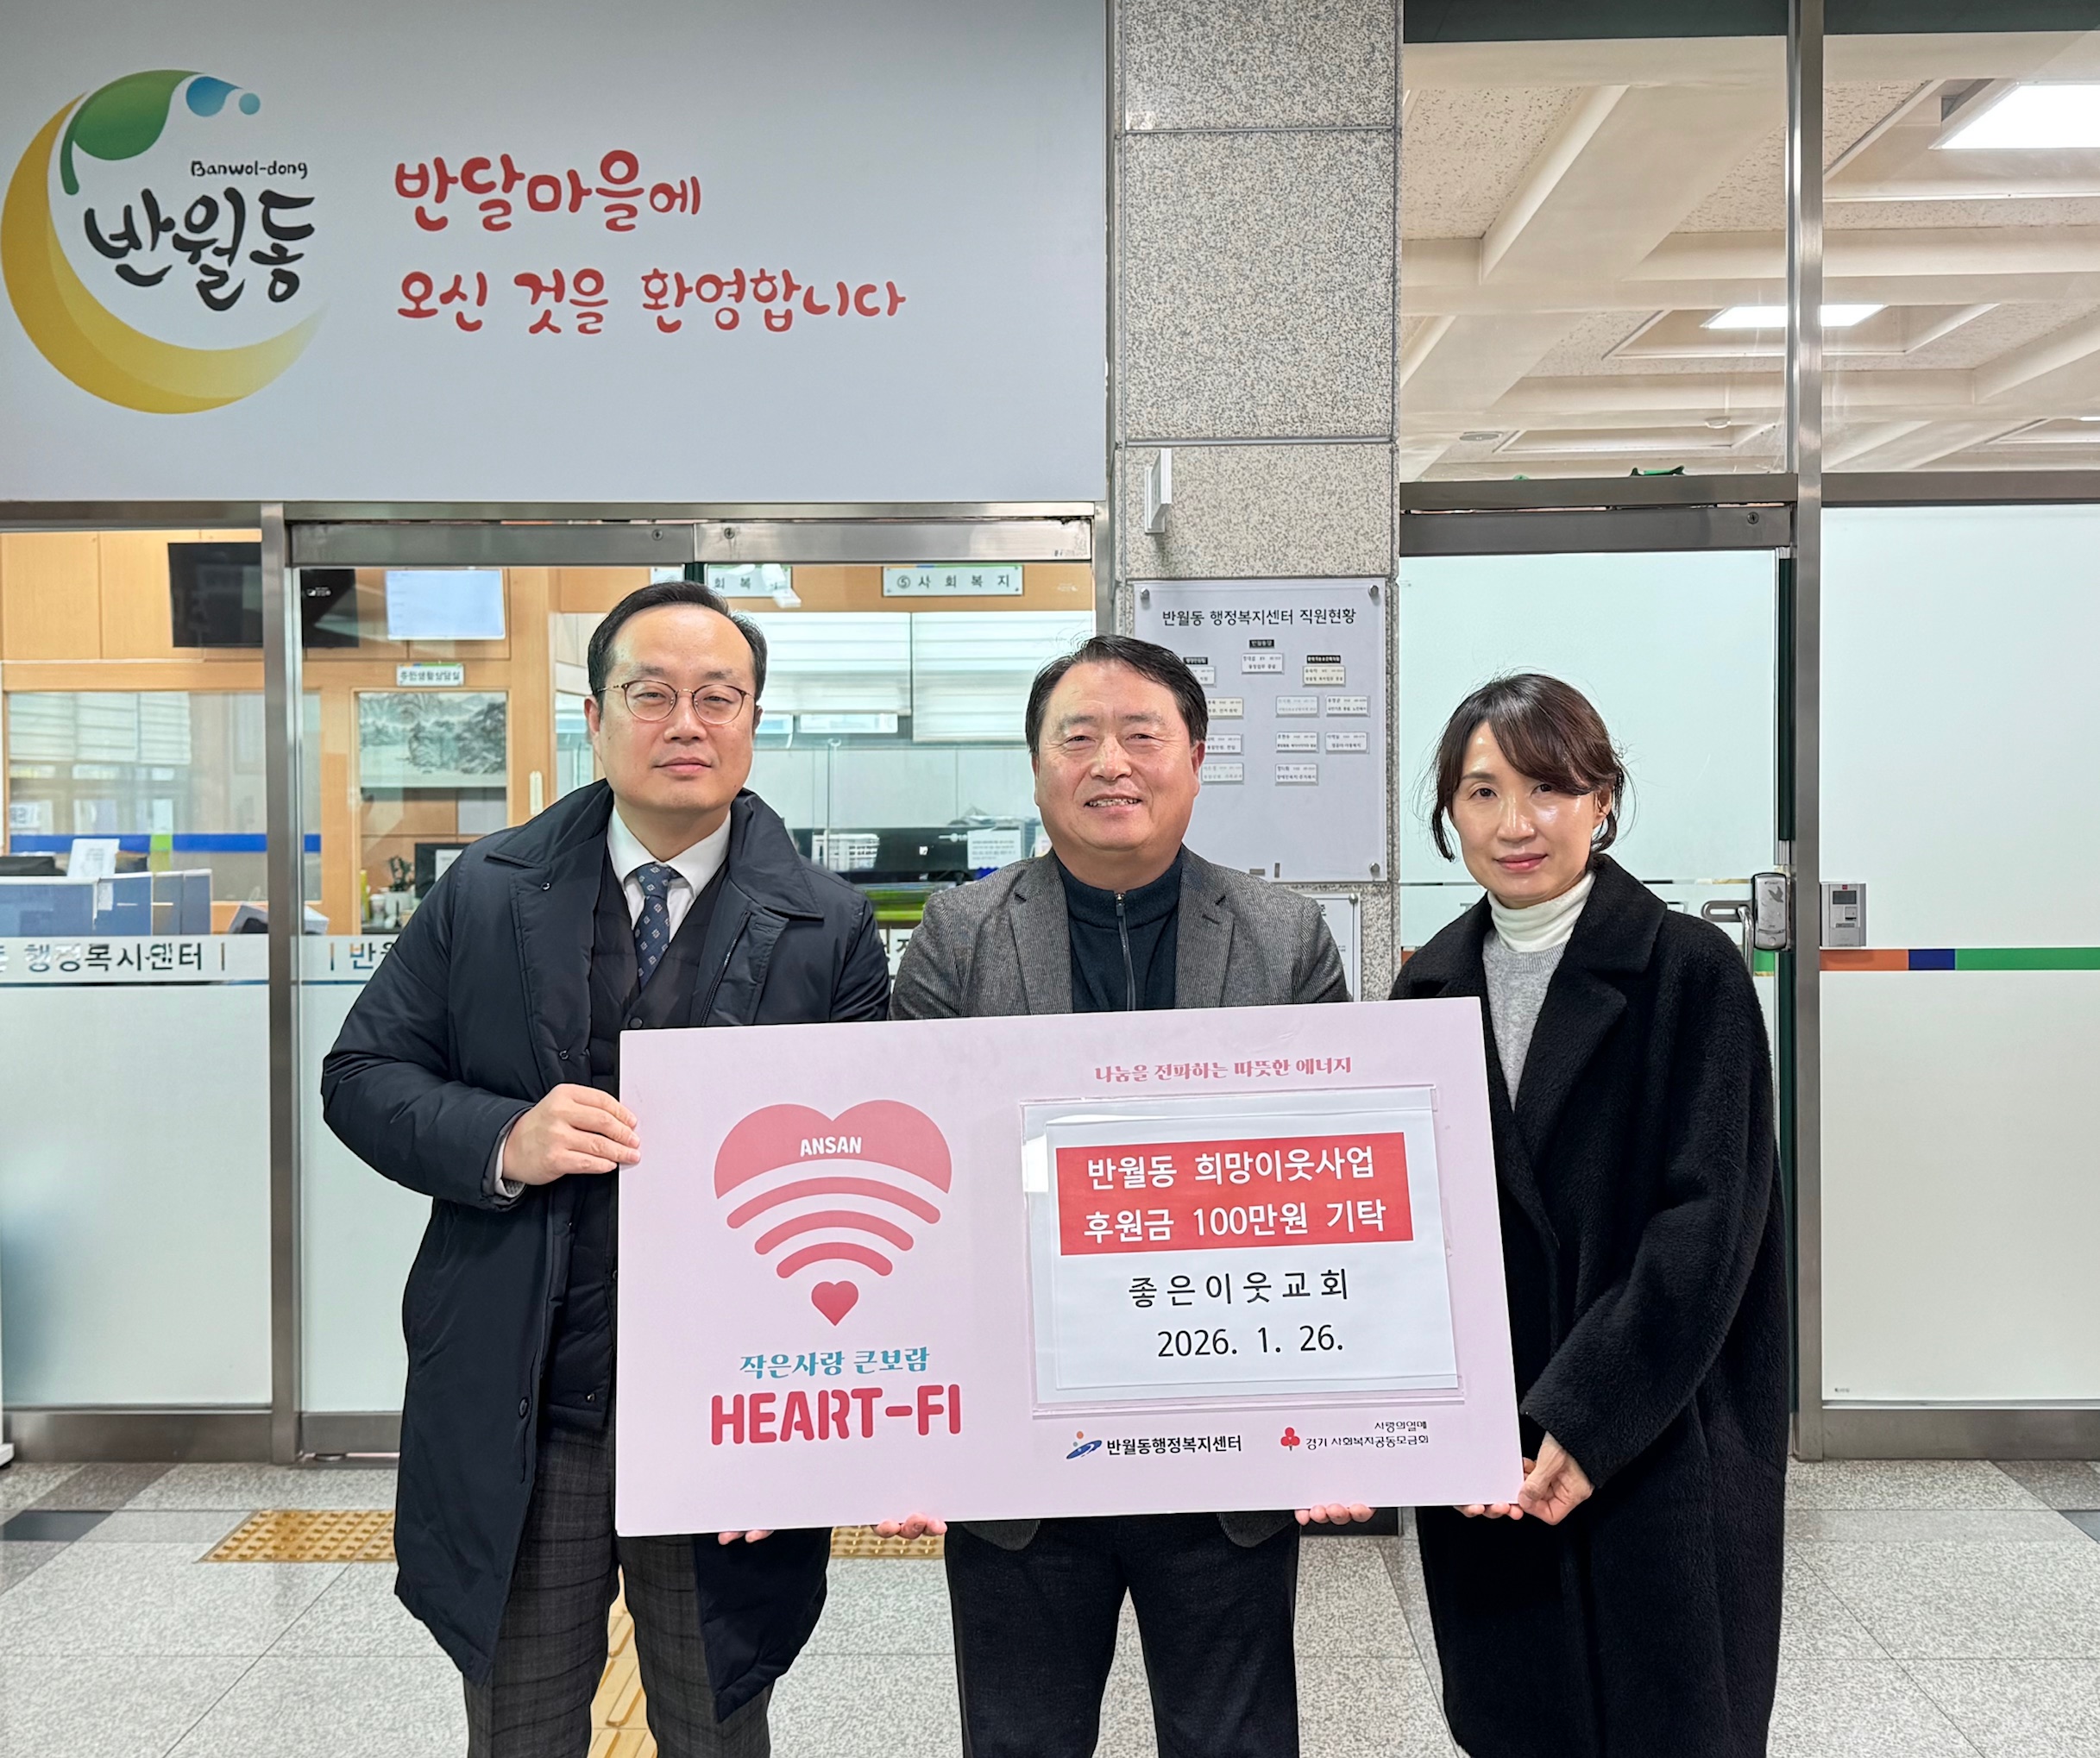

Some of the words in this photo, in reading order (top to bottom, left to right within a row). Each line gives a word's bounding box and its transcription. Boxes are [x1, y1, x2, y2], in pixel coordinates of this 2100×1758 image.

[191, 160, 308, 179] Banwol-dong
[394, 149, 701, 232] 반달마을에
[84, 186, 315, 311] 반월동
[397, 271, 487, 332] 오신
[513, 267, 609, 335] 것을
[640, 267, 907, 334] 환영합니다
[1162, 610, 1205, 626] 반월동
[1210, 609, 1293, 626] 행정복지센터
[1299, 608, 1356, 625] 직원현황
[1095, 1064, 1147, 1083] 나눔을
[1154, 1062, 1229, 1081] 전파하는
[1234, 1058, 1291, 1077] 따뜻한
[1296, 1057, 1351, 1075] 에너지
[800, 1136, 862, 1157] ANSAN
[1088, 1155, 1178, 1190] 반월동
[1194, 1146, 1374, 1185] 희망이웃사업
[1084, 1209, 1174, 1244] 후원금
[1193, 1202, 1308, 1236] 100만원
[1326, 1198, 1386, 1233] 기탁
[1129, 1268, 1348, 1309] 좋은이웃교회
[1158, 1328, 1237, 1358] 2026.
[1257, 1327, 1281, 1353] 1.
[1299, 1324, 1343, 1352] 26.
[739, 1350, 846, 1379] 작은사랑
[854, 1347, 930, 1374] 큰보람
[711, 1384, 961, 1446] HEART-FI
[1107, 1435, 1242, 1456] 반월동행정복지센터
[1306, 1438, 1327, 1450] 경기
[1331, 1435, 1429, 1448] 사회복지공동모금회
